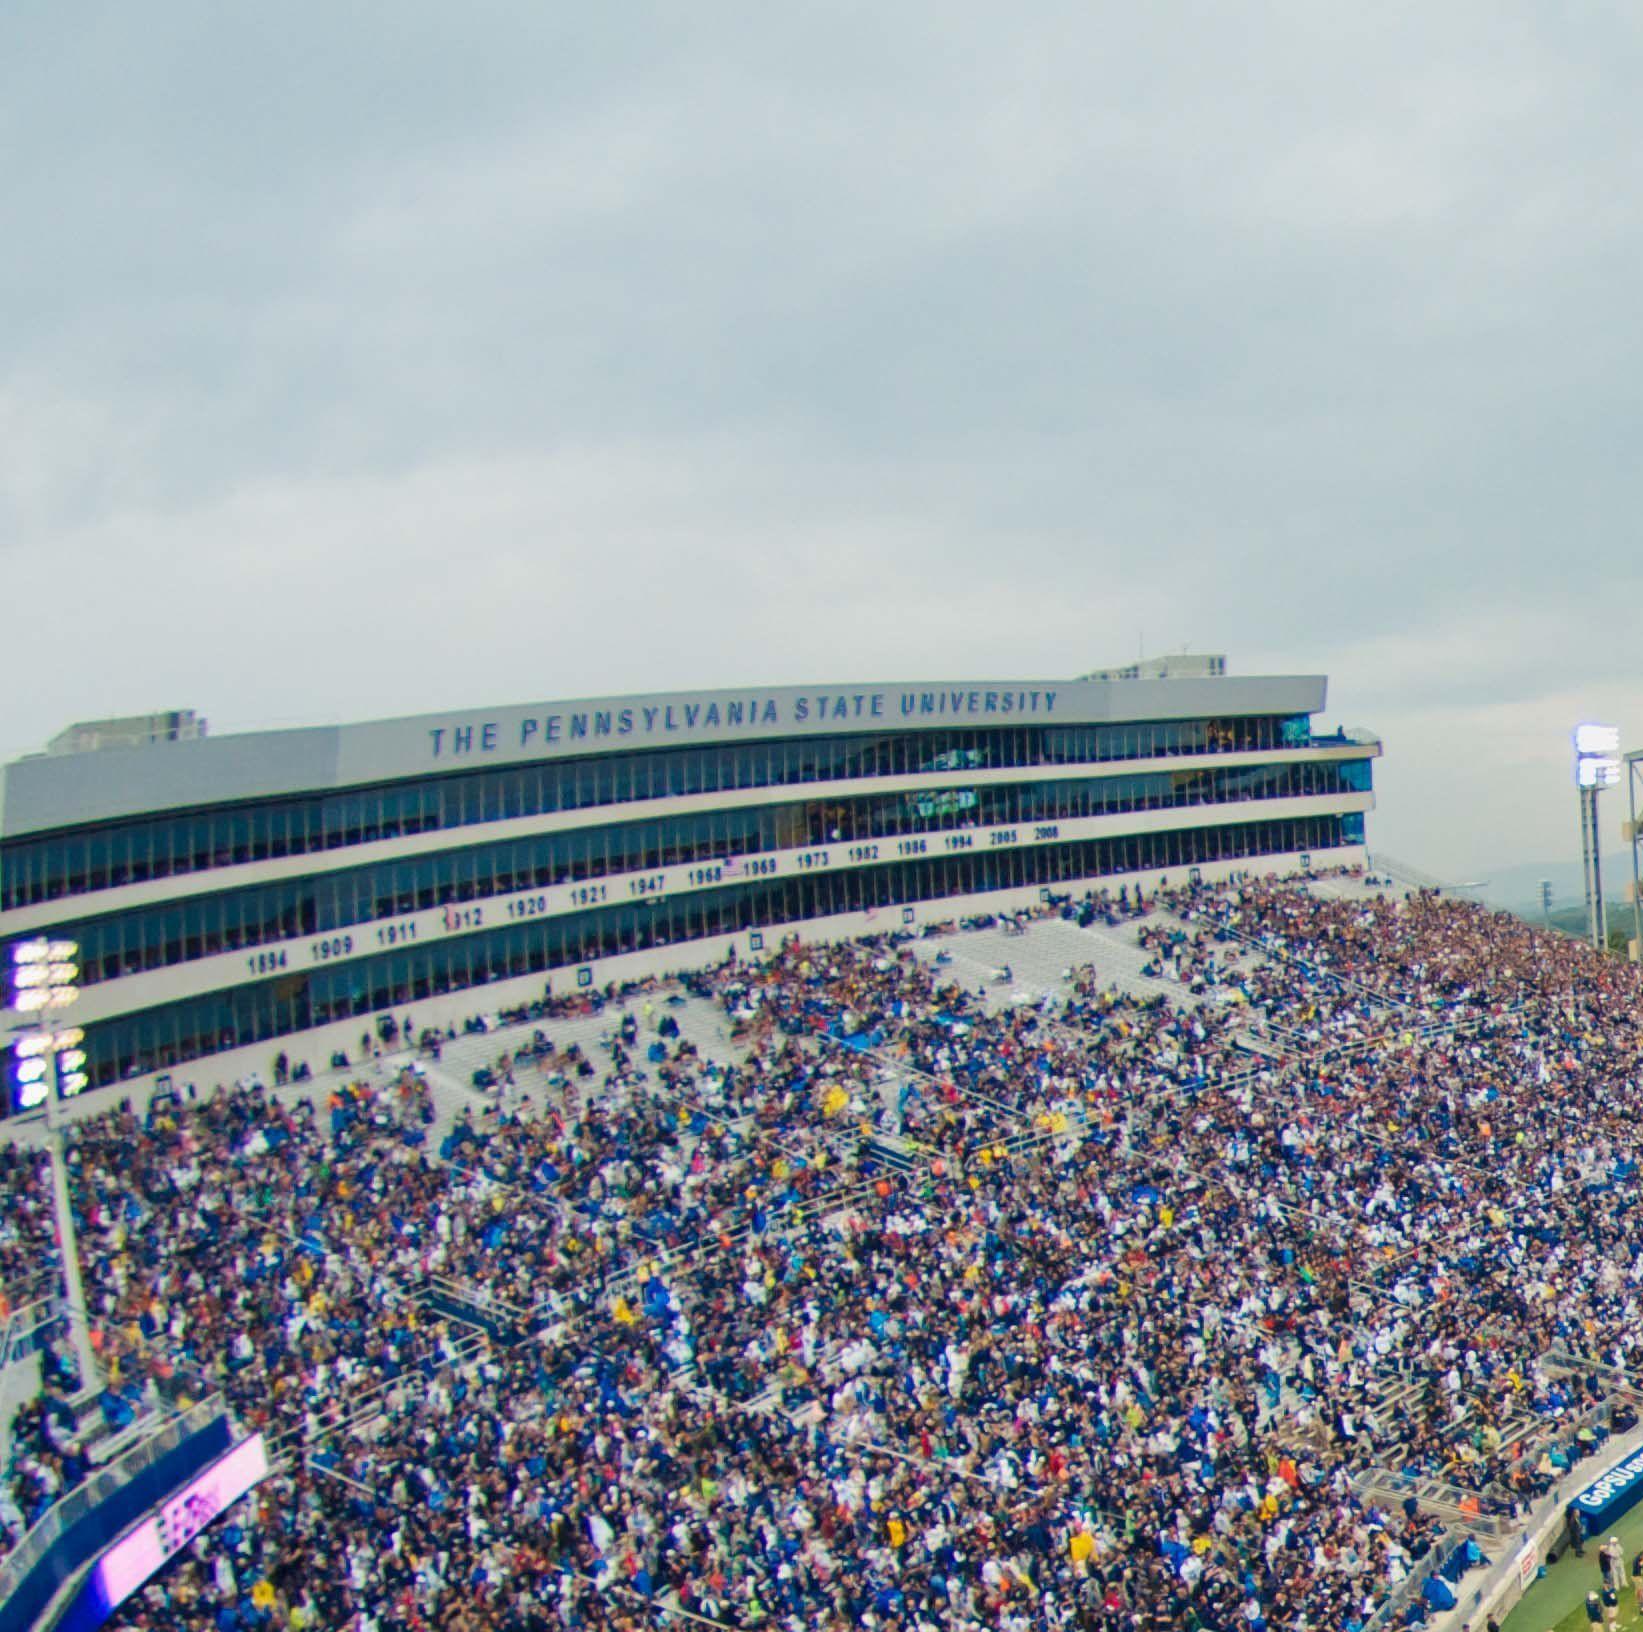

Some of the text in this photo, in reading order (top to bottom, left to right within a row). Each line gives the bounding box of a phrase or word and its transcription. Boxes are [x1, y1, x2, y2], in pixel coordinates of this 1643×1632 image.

[428, 691, 1057, 758] THE PENNSYLVANIA STATE UNIVERSITY
[377, 921, 417, 946] 1911
[797, 851, 829, 870] 1973
